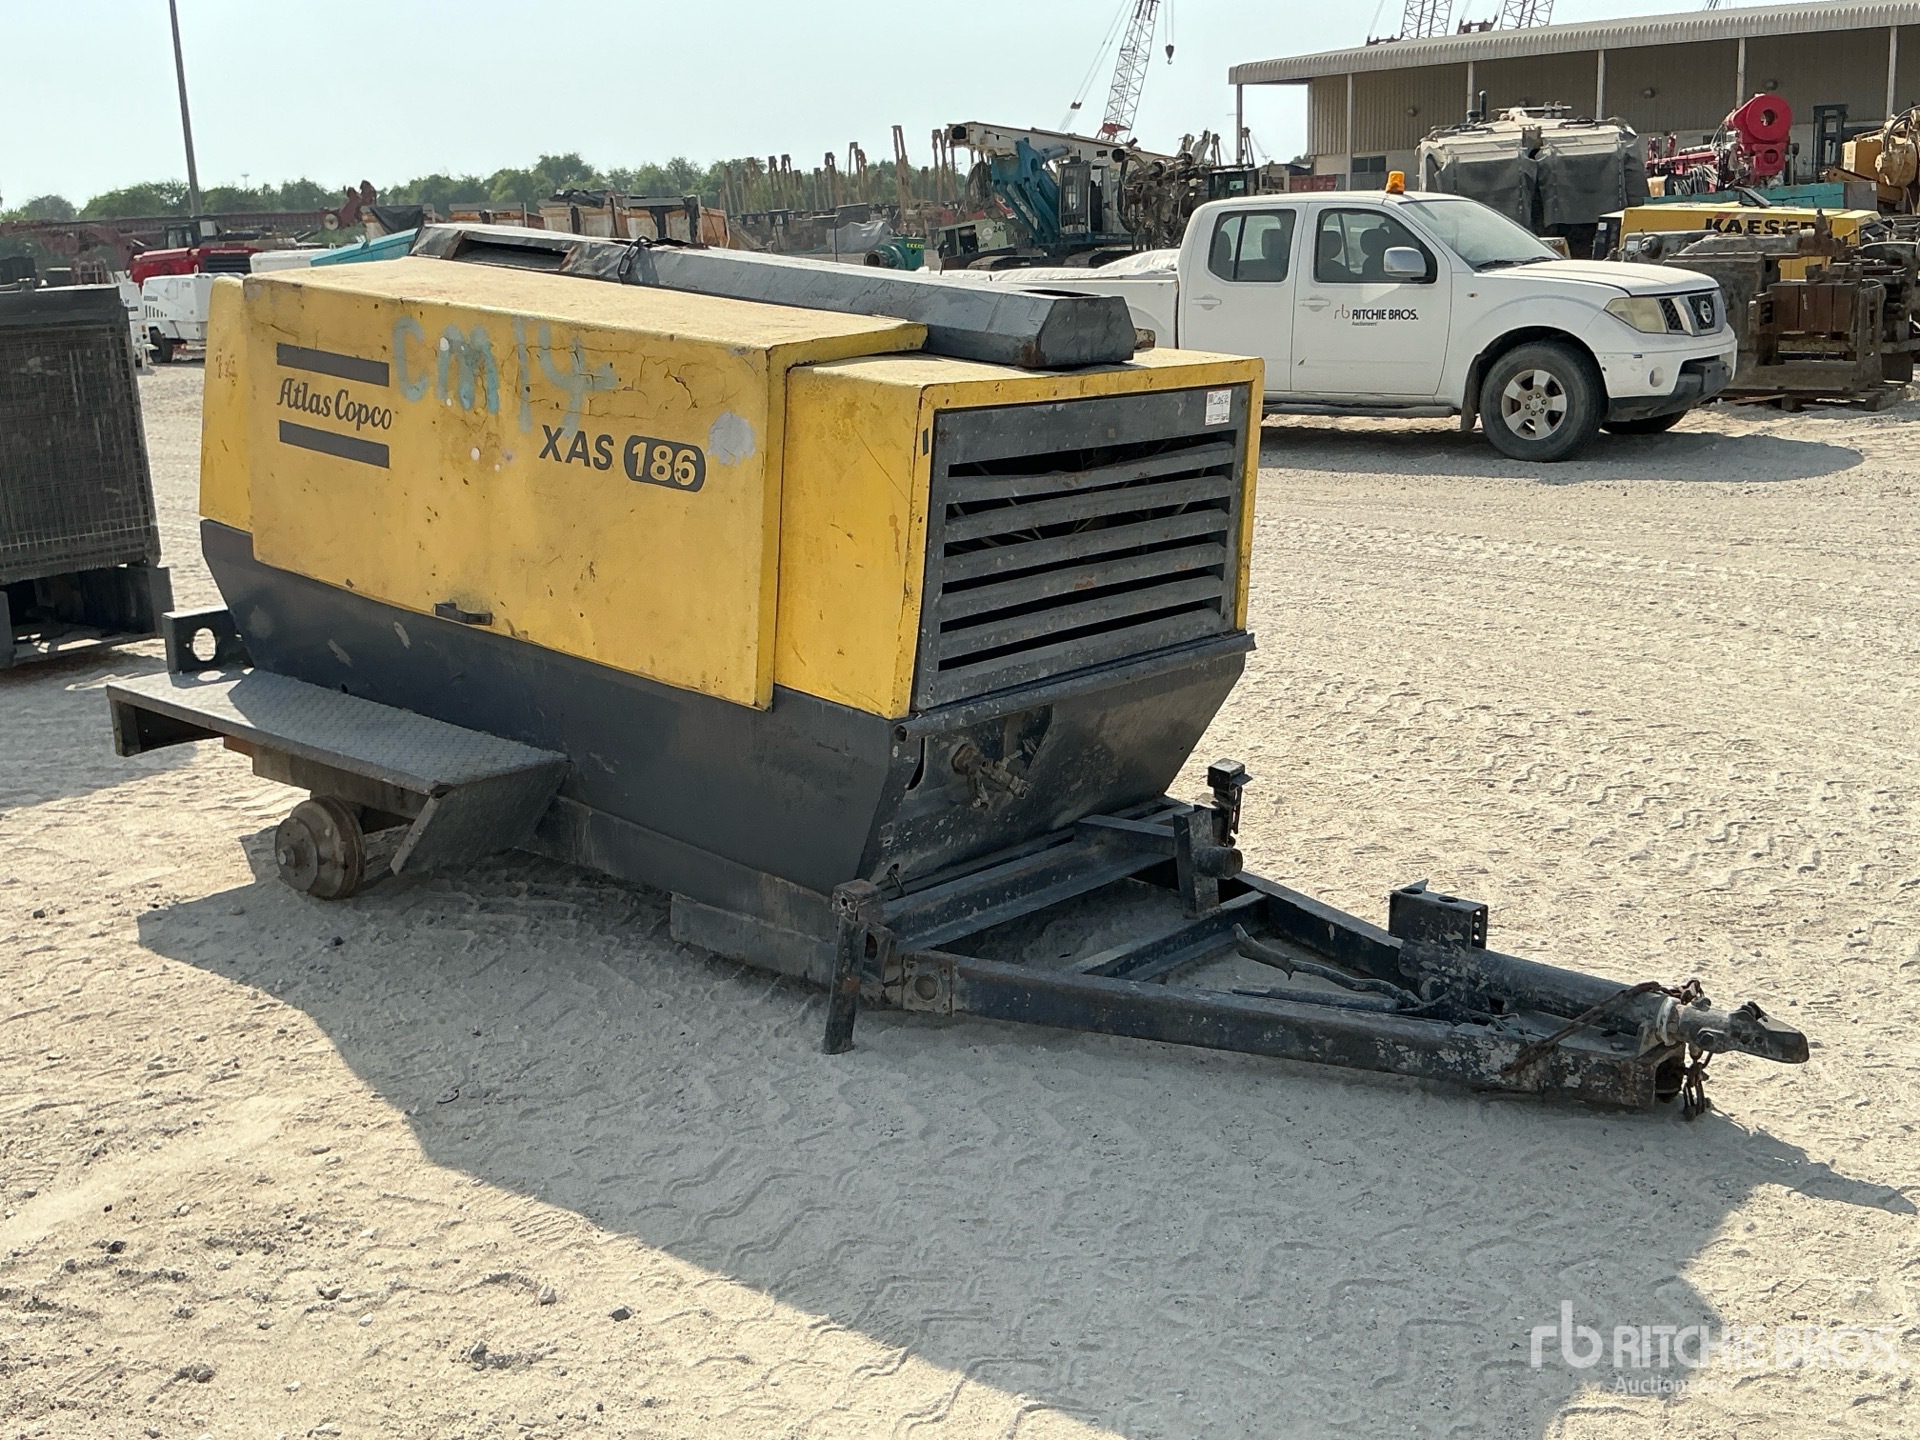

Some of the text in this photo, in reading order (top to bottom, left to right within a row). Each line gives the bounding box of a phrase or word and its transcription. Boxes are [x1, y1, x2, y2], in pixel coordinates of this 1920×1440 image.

[1351, 309, 1387, 320] RITCHIE
[1388, 309, 1419, 320] BROS.
[277, 377, 393, 431] Atlas Copco
[538, 424, 697, 486] XAS 186
